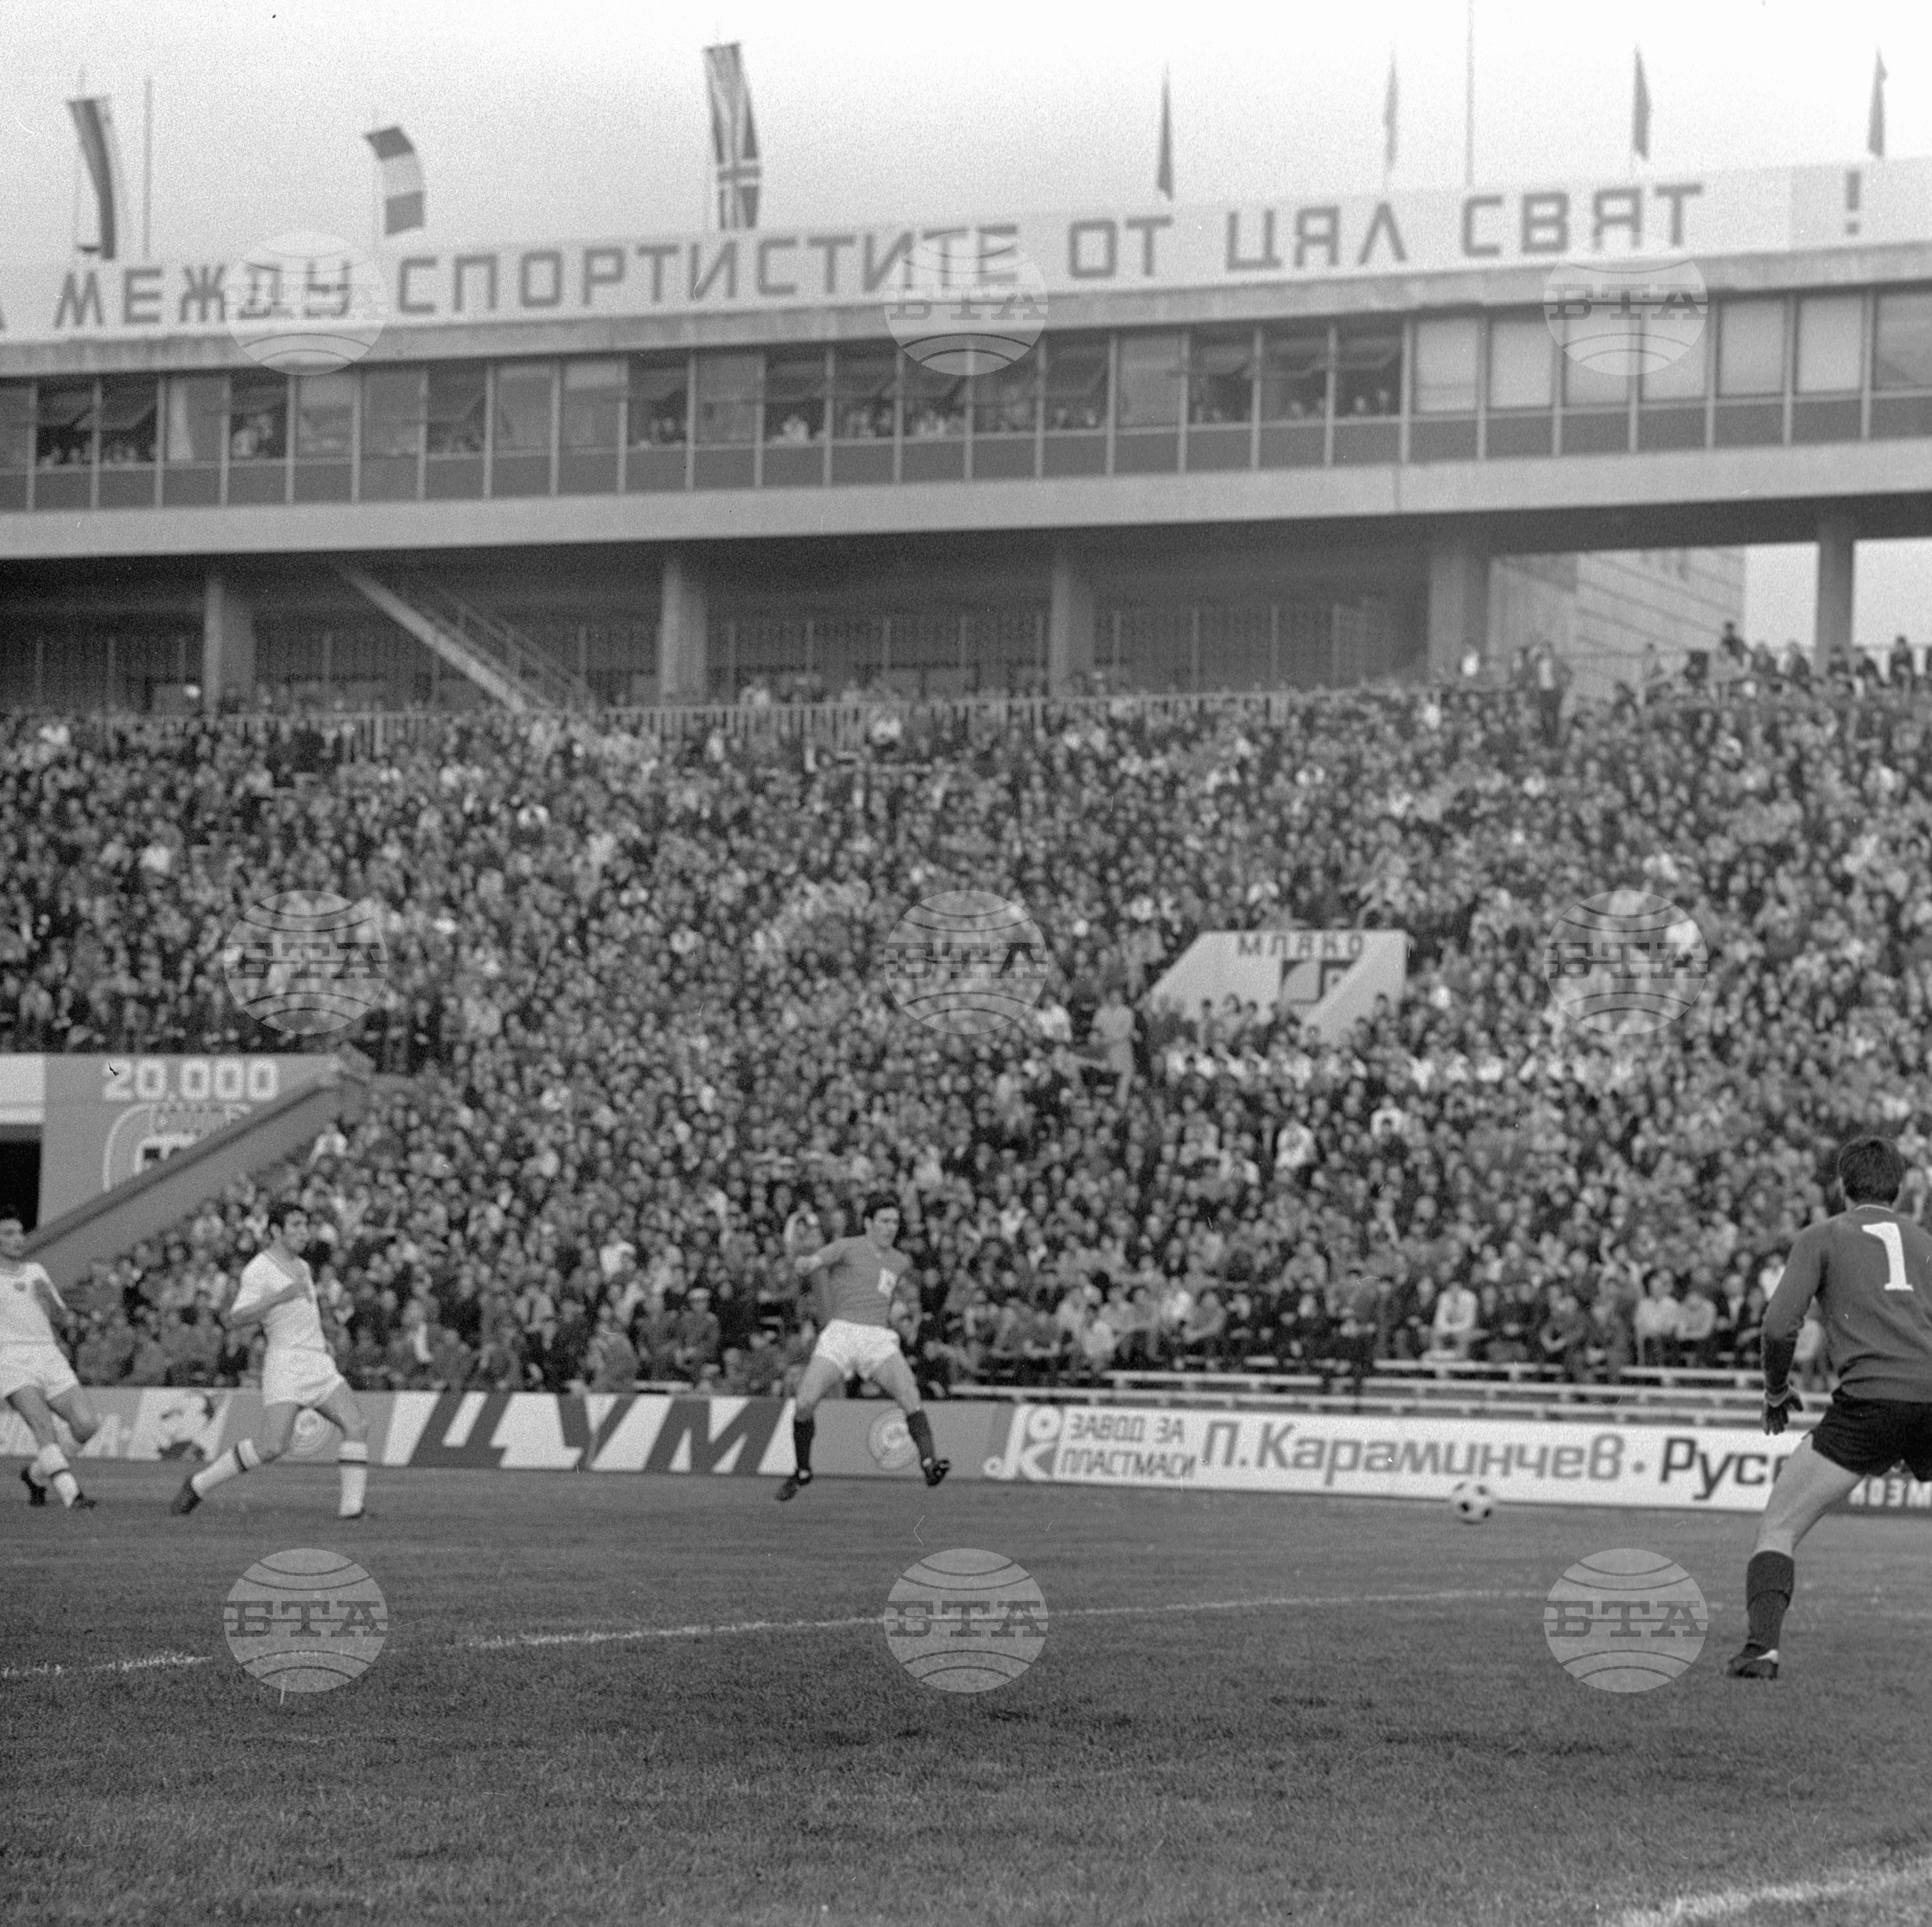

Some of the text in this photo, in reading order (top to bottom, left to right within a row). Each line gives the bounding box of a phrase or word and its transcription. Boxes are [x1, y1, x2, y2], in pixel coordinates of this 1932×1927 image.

[55, 260, 353, 329] МЕЖДУ
[398, 224, 1018, 314] СПОРТИСТИТЕ
[1068, 214, 1173, 279] ОТ
[1226, 201, 1407, 271] ЦЯЛ
[1462, 184, 1704, 257] СВЯТ
[102, 1058, 279, 1101] 20.000
[1861, 1221, 1914, 1291] 1
[408, 1393, 791, 1474] ЦУМ
[1070, 1413, 1184, 1445] ЗАВОД ЗА
